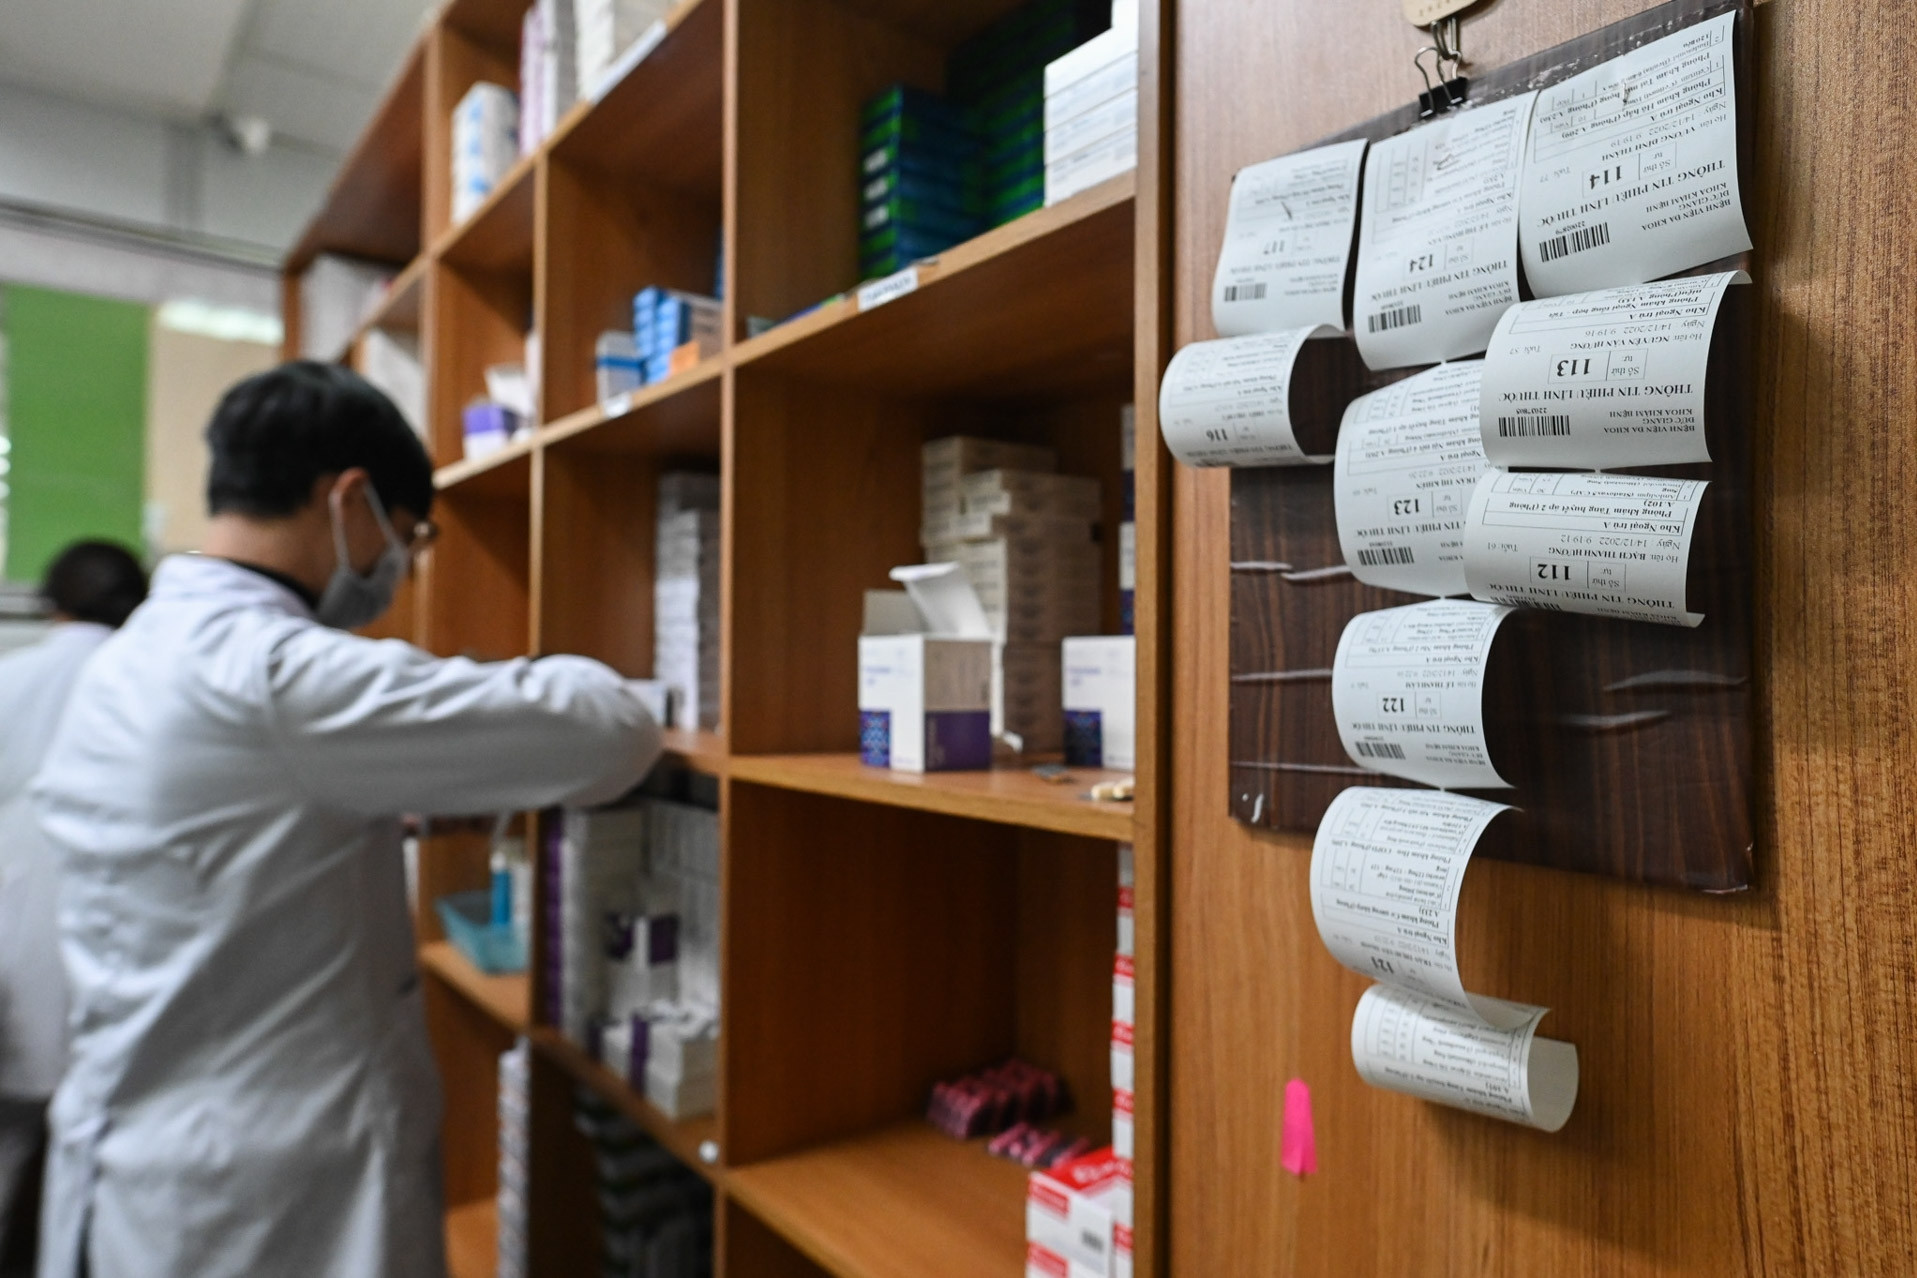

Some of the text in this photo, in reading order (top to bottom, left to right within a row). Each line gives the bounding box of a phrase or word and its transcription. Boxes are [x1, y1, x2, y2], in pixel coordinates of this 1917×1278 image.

[1681, 51, 1709, 68] Phòng
[1682, 77, 1710, 93] Phòng
[1702, 87, 1722, 99] Kho
[1567, 99, 1596, 113] (Phòng
[1675, 96, 1700, 112] Ngoại
[1590, 113, 1620, 128] (Phòng
[1677, 160, 1724, 181] THÔNG
[1589, 165, 1620, 189] 114
[1652, 176, 1671, 189] TIN
[1699, 182, 1726, 195] KHOA
[1580, 197, 1608, 213] LĨNH
[1646, 200, 1668, 212] BỆNH
[1679, 196, 1706, 210] GIANG
[1705, 198, 1730, 211] BỆNH
[1683, 207, 1703, 218] VIỆN
[1641, 218, 1666, 230] KHOA
[1409, 254, 1432, 272] 124
[1668, 295, 1698, 303] Phòng
[1611, 302, 1636, 310] Ngoại
[1654, 308, 1682, 317] Ngoại
[1681, 319, 1704, 328] Ngày
[1628, 335, 1668, 345] NGUYỄN
[1688, 332, 1702, 340] Họ
[1509, 346, 1519, 354] 57
[1556, 358, 1589, 376] 113
[1610, 366, 1639, 375] Số thứ
[1498, 384, 1692, 402] THÔNG TIN PHIẾU LĨNH THUỐC
[1609, 409, 1632, 417] BỆNH
[1675, 416, 1694, 424] ĐỨC
[1206, 428, 1227, 442] 116
[1393, 498, 1419, 515] 123
[1508, 501, 1539, 510] (Phòng
[1561, 504, 1585, 513] huyết
[1588, 505, 1609, 514] Tăng
[1641, 508, 1671, 517] Phòng
[1443, 521, 1459, 529] TIN
[1629, 521, 1657, 531] Ngoại
[1659, 524, 1680, 532] Kho
[1487, 542, 1496, 550] 61
[1599, 536, 1646, 547] 14/12/2022
[1656, 538, 1680, 549] Ngày
[1618, 551, 1645, 560] BẠCH
[1664, 554, 1678, 562] Họ
[1537, 563, 1569, 580] 112
[1592, 577, 1618, 588] Số thứ
[1529, 587, 1556, 596] LĨNH
[1601, 594, 1621, 602] TIN
[1627, 597, 1672, 608] THÔNG
[1382, 697, 1404, 712] 122
[1370, 956, 1393, 974] 121
